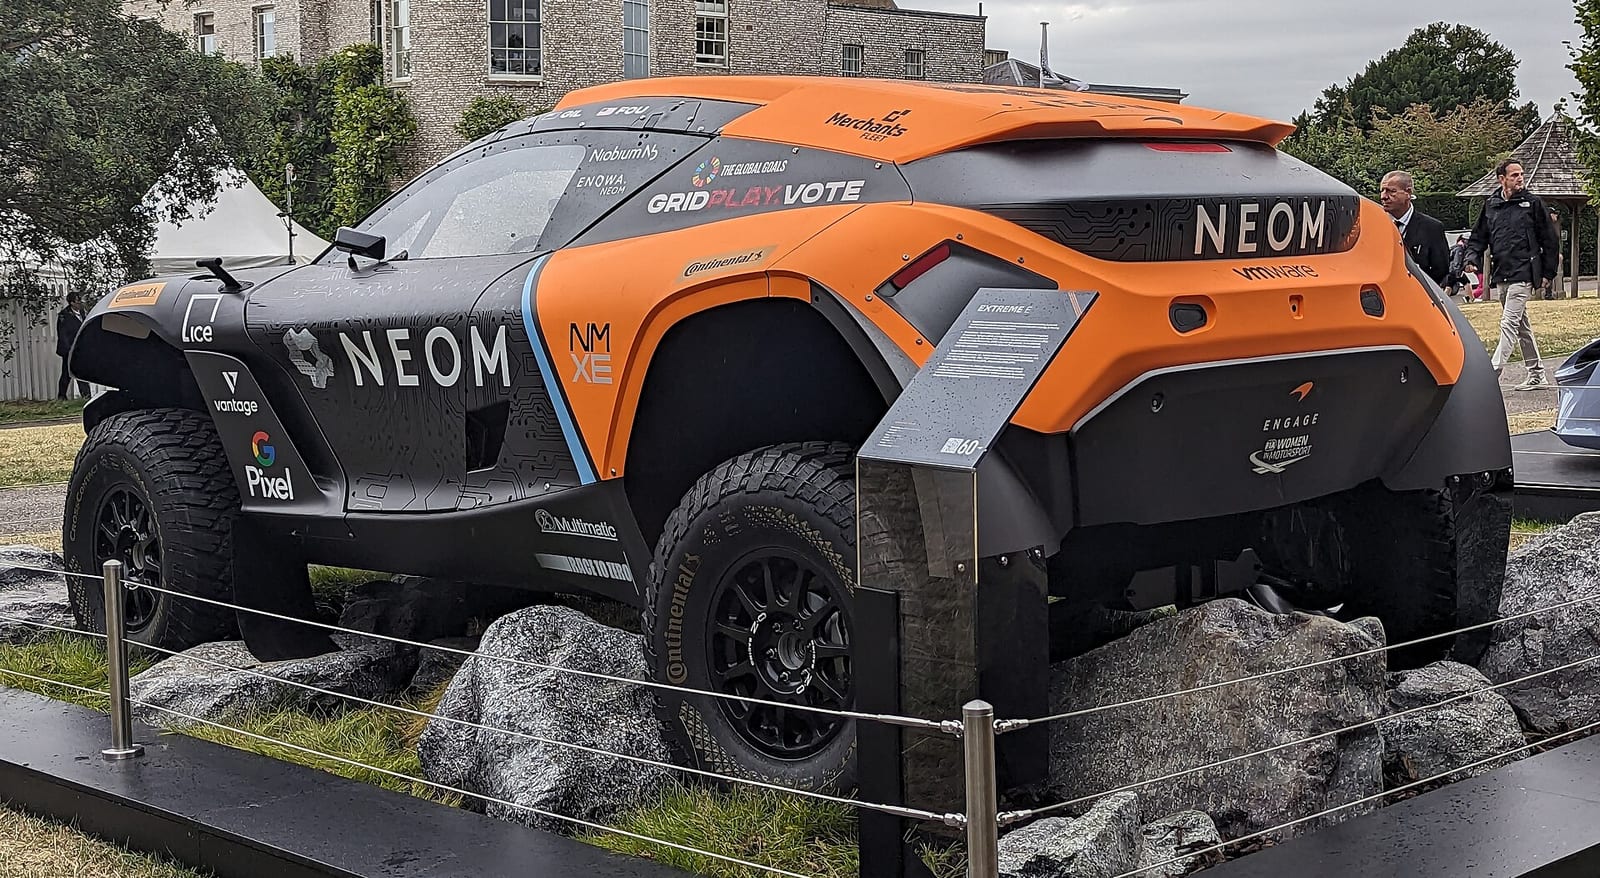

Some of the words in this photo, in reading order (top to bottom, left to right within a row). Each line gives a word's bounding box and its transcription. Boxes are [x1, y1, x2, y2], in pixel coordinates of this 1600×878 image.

[824, 112, 908, 137] Merchants
[859, 132, 888, 142] FLEET
[720, 164, 734, 176] THE
[733, 162, 762, 176] GLOBAL
[761, 160, 788, 173] GOALS
[599, 186, 627, 196] NEOM
[1194, 200, 1325, 255] NEOM
[683, 251, 753, 277] Continental
[1232, 264, 1319, 281] vmware
[977, 304, 1024, 313] EXTREME
[570, 322, 610, 352] NM
[339, 325, 511, 387] NEOM
[570, 353, 613, 384] XE
[214, 399, 259, 416] vantage
[1263, 413, 1319, 431] ENGAGE
[1268, 445, 1312, 460] MOTORSPORT
[1277, 435, 1309, 450] WOMEN
[245, 465, 294, 500] Pixel
[554, 516, 617, 538] Multimatic
[665, 562, 695, 684] Continental
